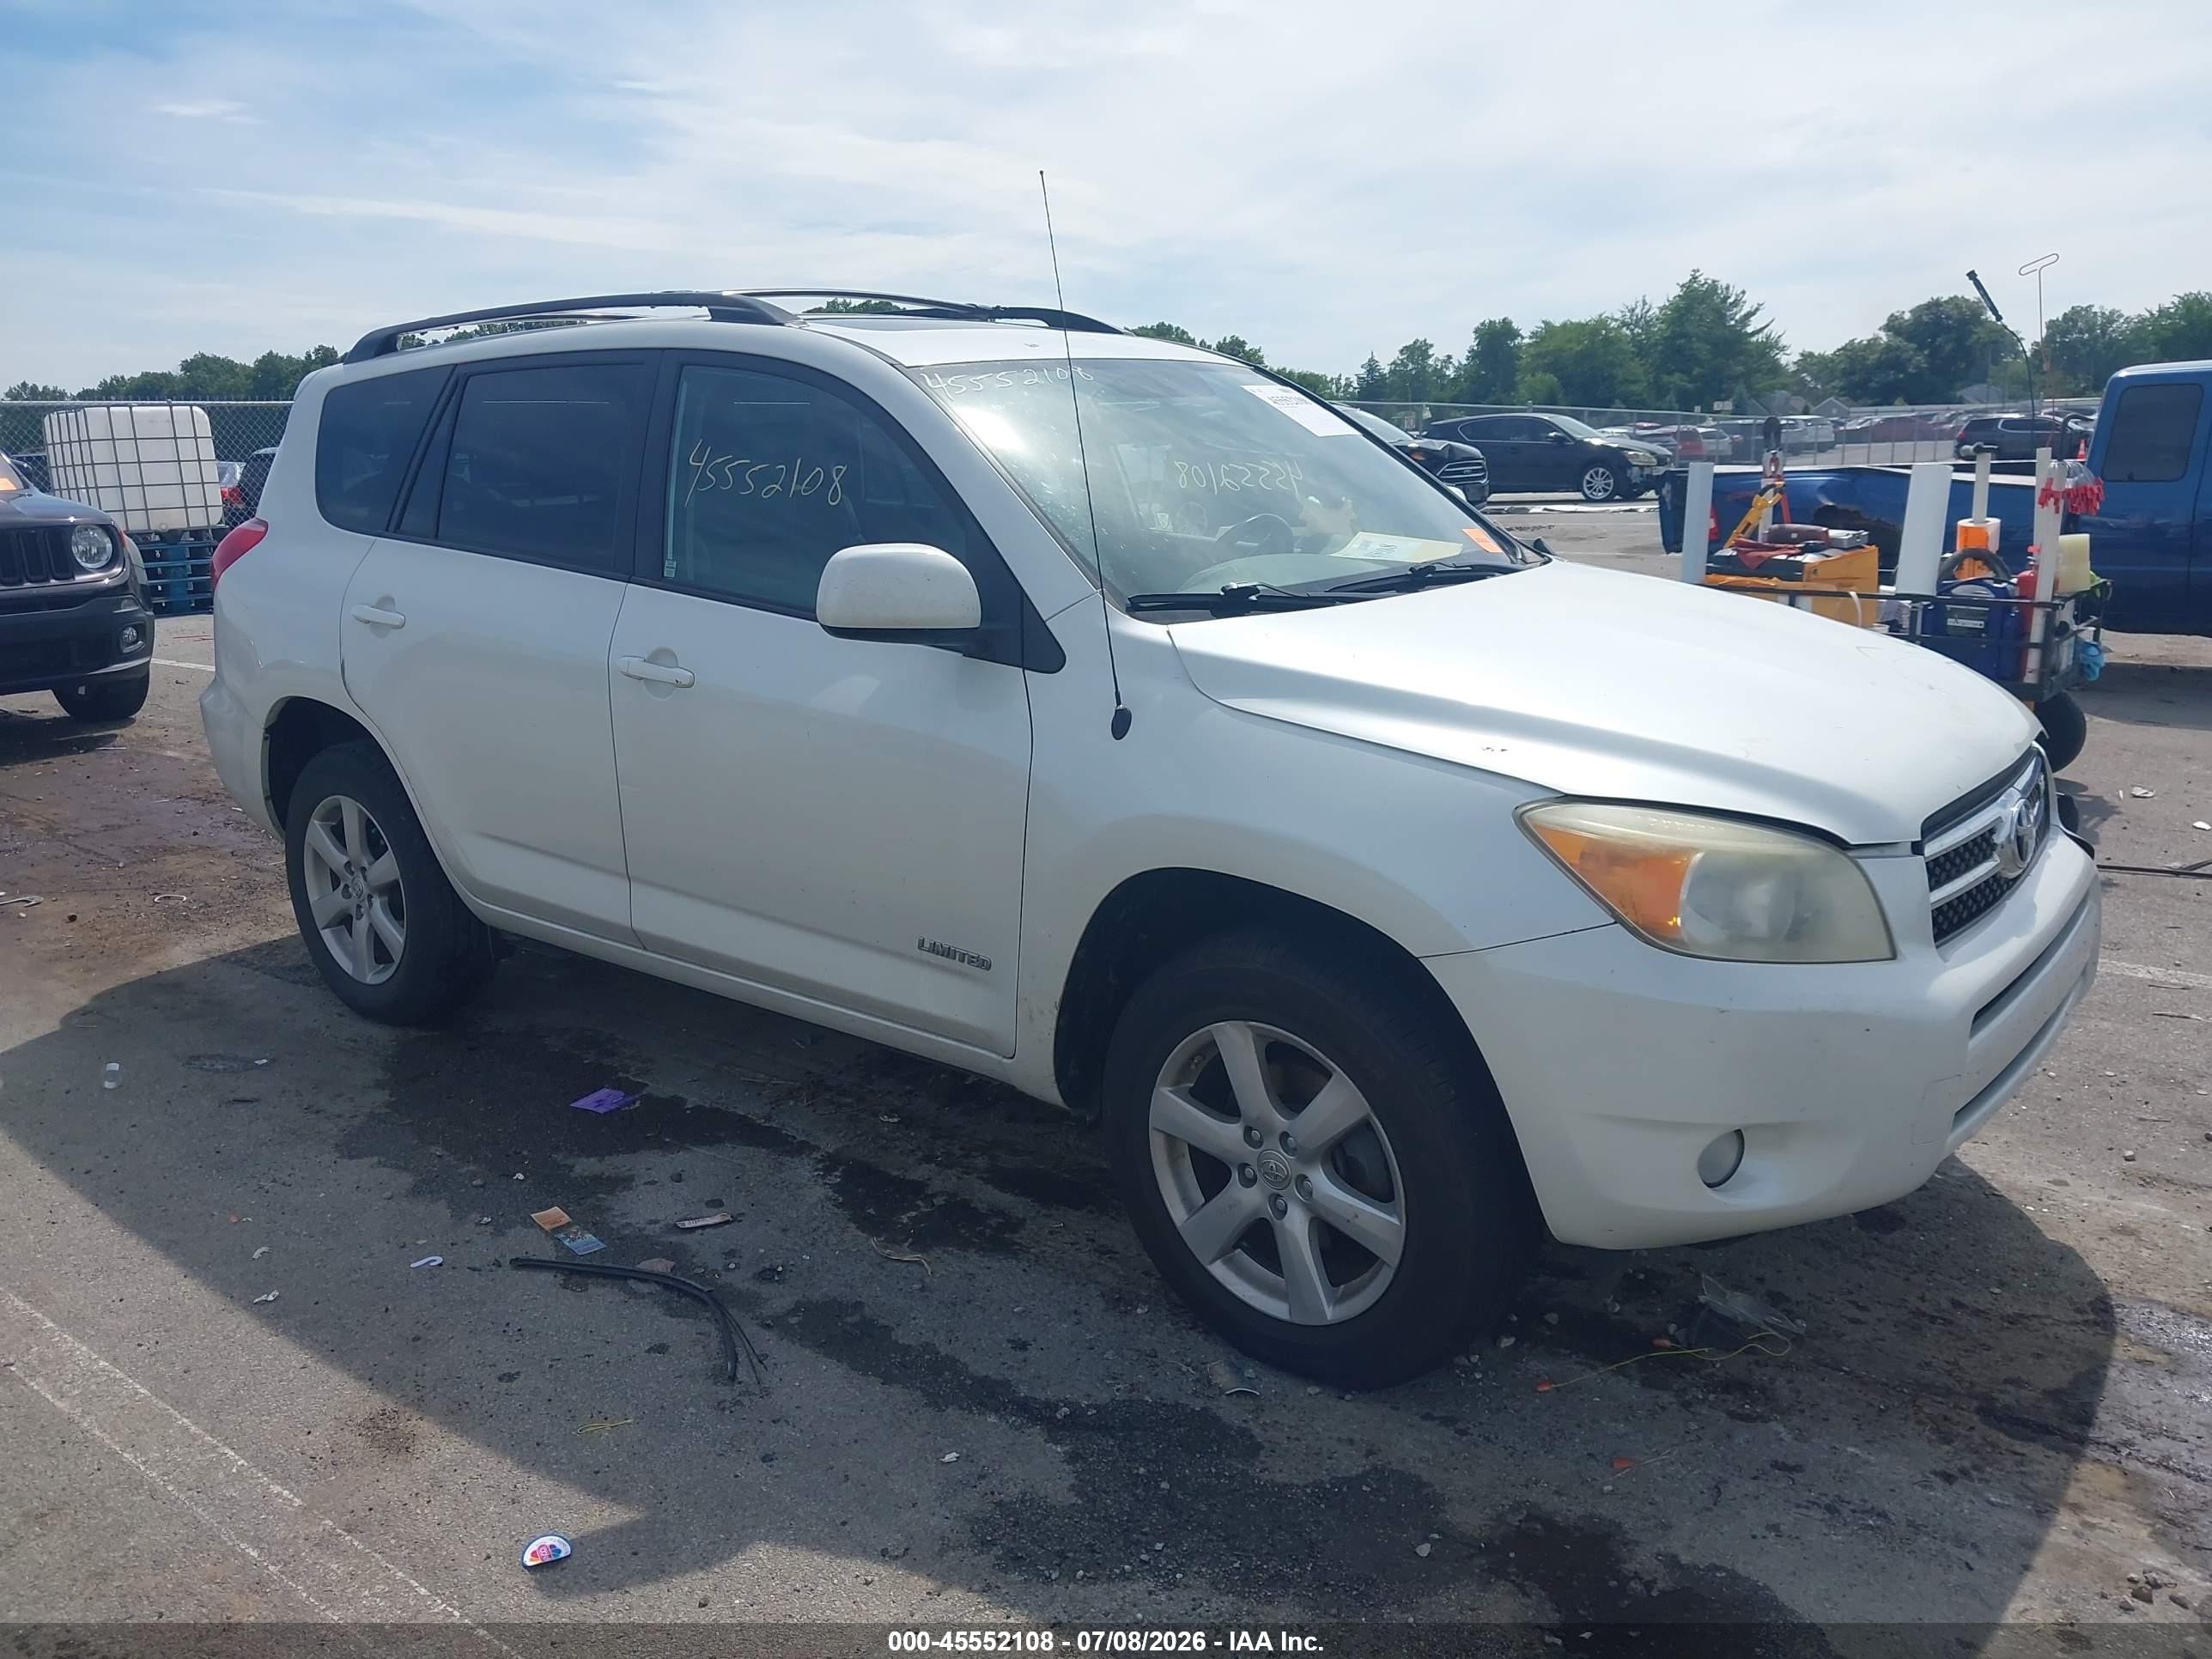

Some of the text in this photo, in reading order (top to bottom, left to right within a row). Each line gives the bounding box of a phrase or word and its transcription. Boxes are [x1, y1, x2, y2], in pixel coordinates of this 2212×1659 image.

[920, 367, 1094, 401] 45552108
[684, 439, 848, 507] 45552108
[917, 936, 992, 971] LIMITED
